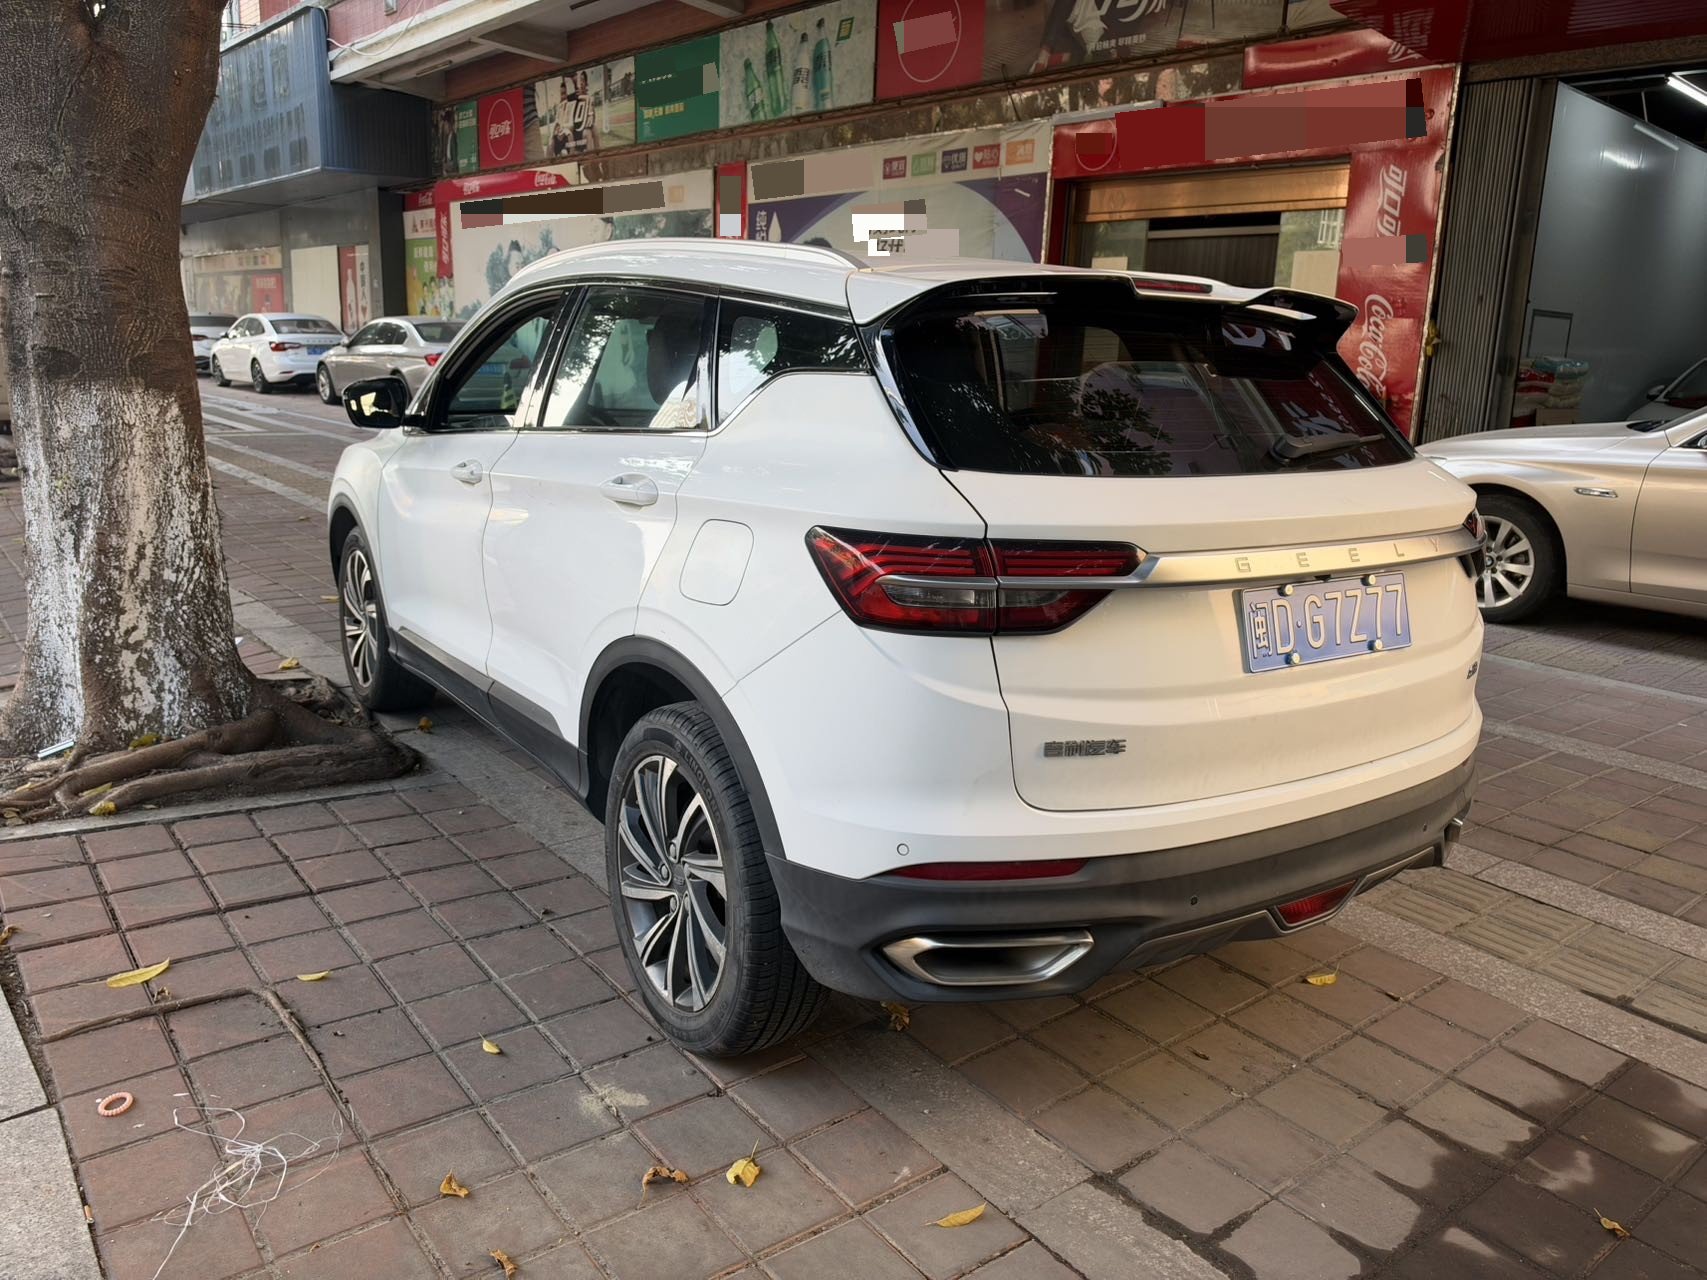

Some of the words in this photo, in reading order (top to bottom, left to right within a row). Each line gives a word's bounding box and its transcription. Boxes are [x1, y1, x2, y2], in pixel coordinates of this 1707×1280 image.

[1374, 163, 1408, 266] 可口可
[1235, 536, 1440, 573] GEELY
[1043, 739, 1128, 757] 吉利汽车
